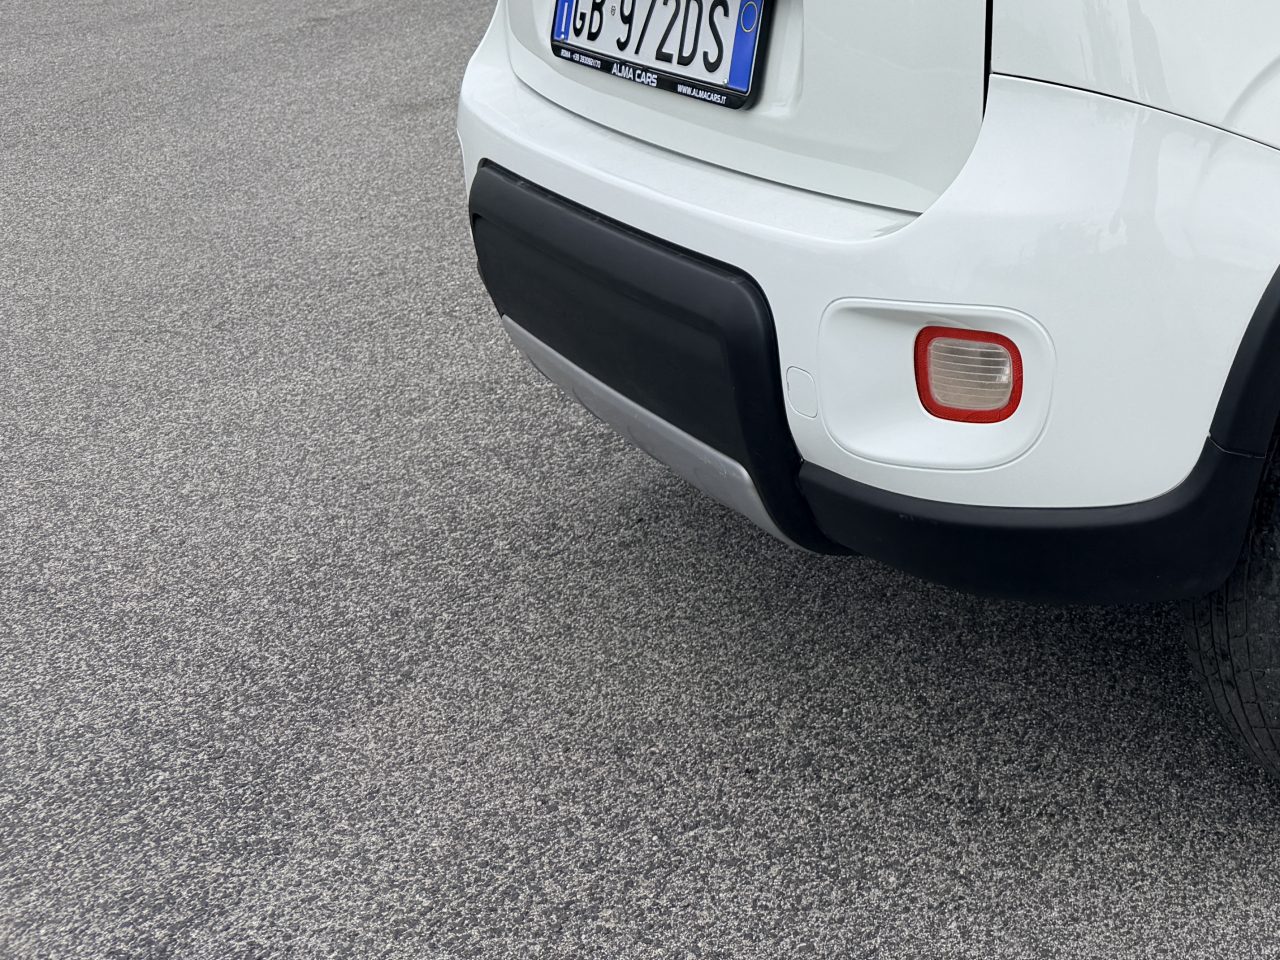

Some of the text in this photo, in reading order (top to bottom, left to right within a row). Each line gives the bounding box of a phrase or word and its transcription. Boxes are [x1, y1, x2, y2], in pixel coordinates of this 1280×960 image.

[611, 62, 658, 87] ALMA CARS
[677, 83, 727, 105] WWW.ALMACARS.IT
